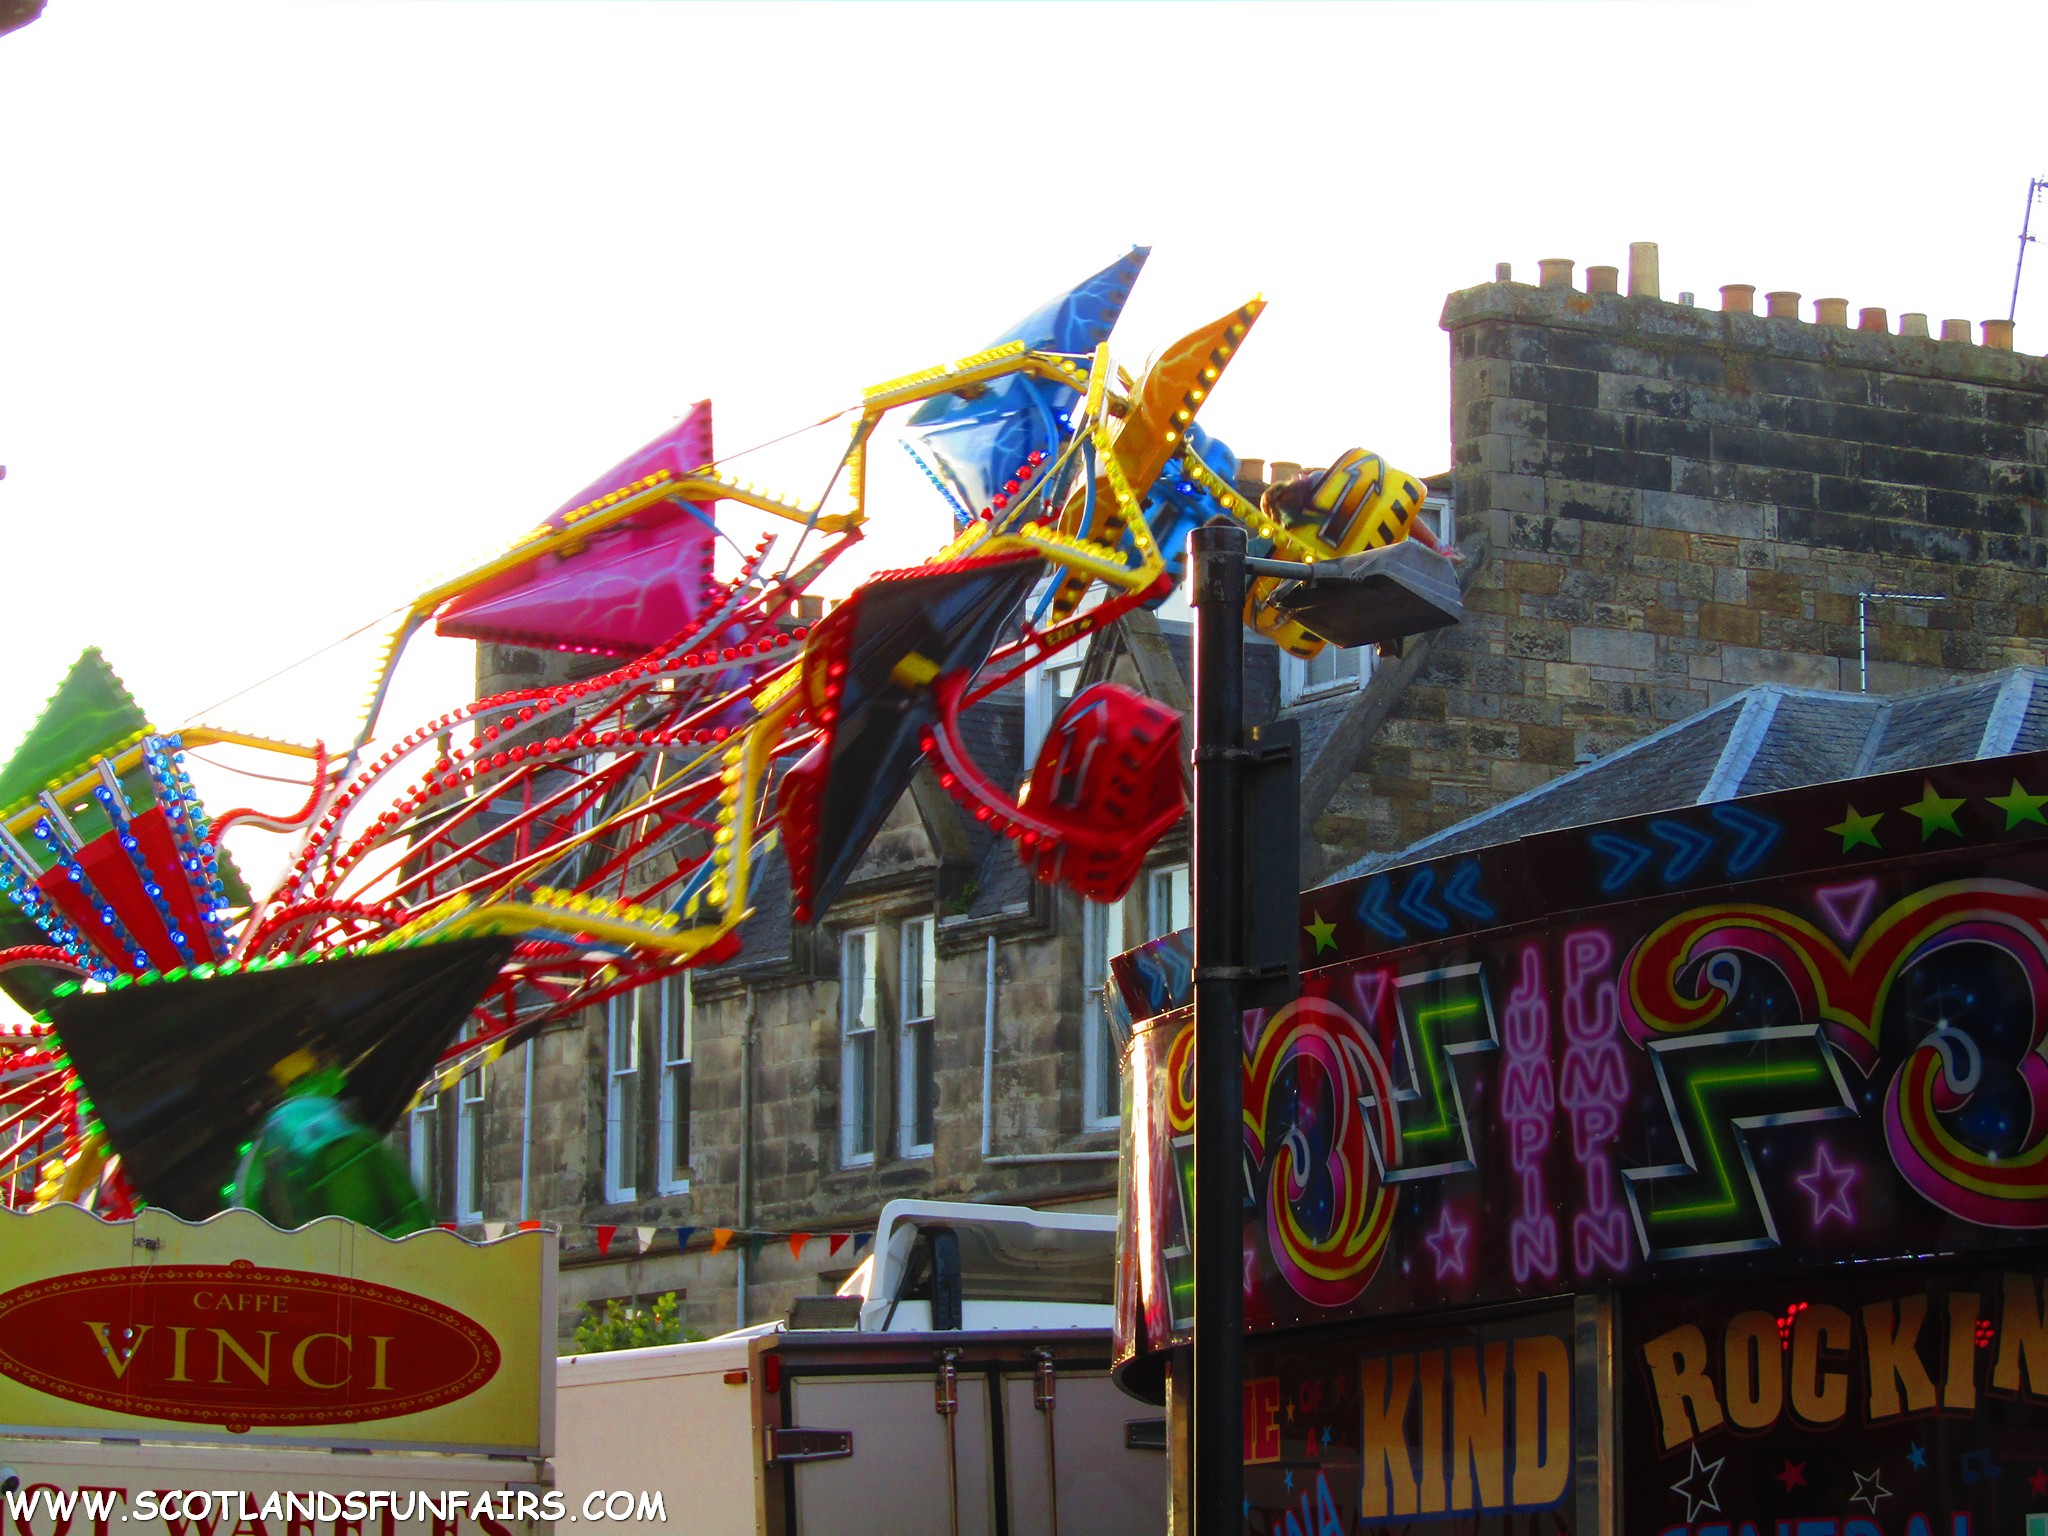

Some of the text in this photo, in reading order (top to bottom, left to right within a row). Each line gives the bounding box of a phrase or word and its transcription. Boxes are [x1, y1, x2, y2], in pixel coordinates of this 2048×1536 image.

[1503, 944, 1557, 1283] JUMPIN
[83, 1320, 396, 1391] VINCI
[193, 1290, 289, 1314] CAFFE
[1359, 1334, 1574, 1524] KIND
